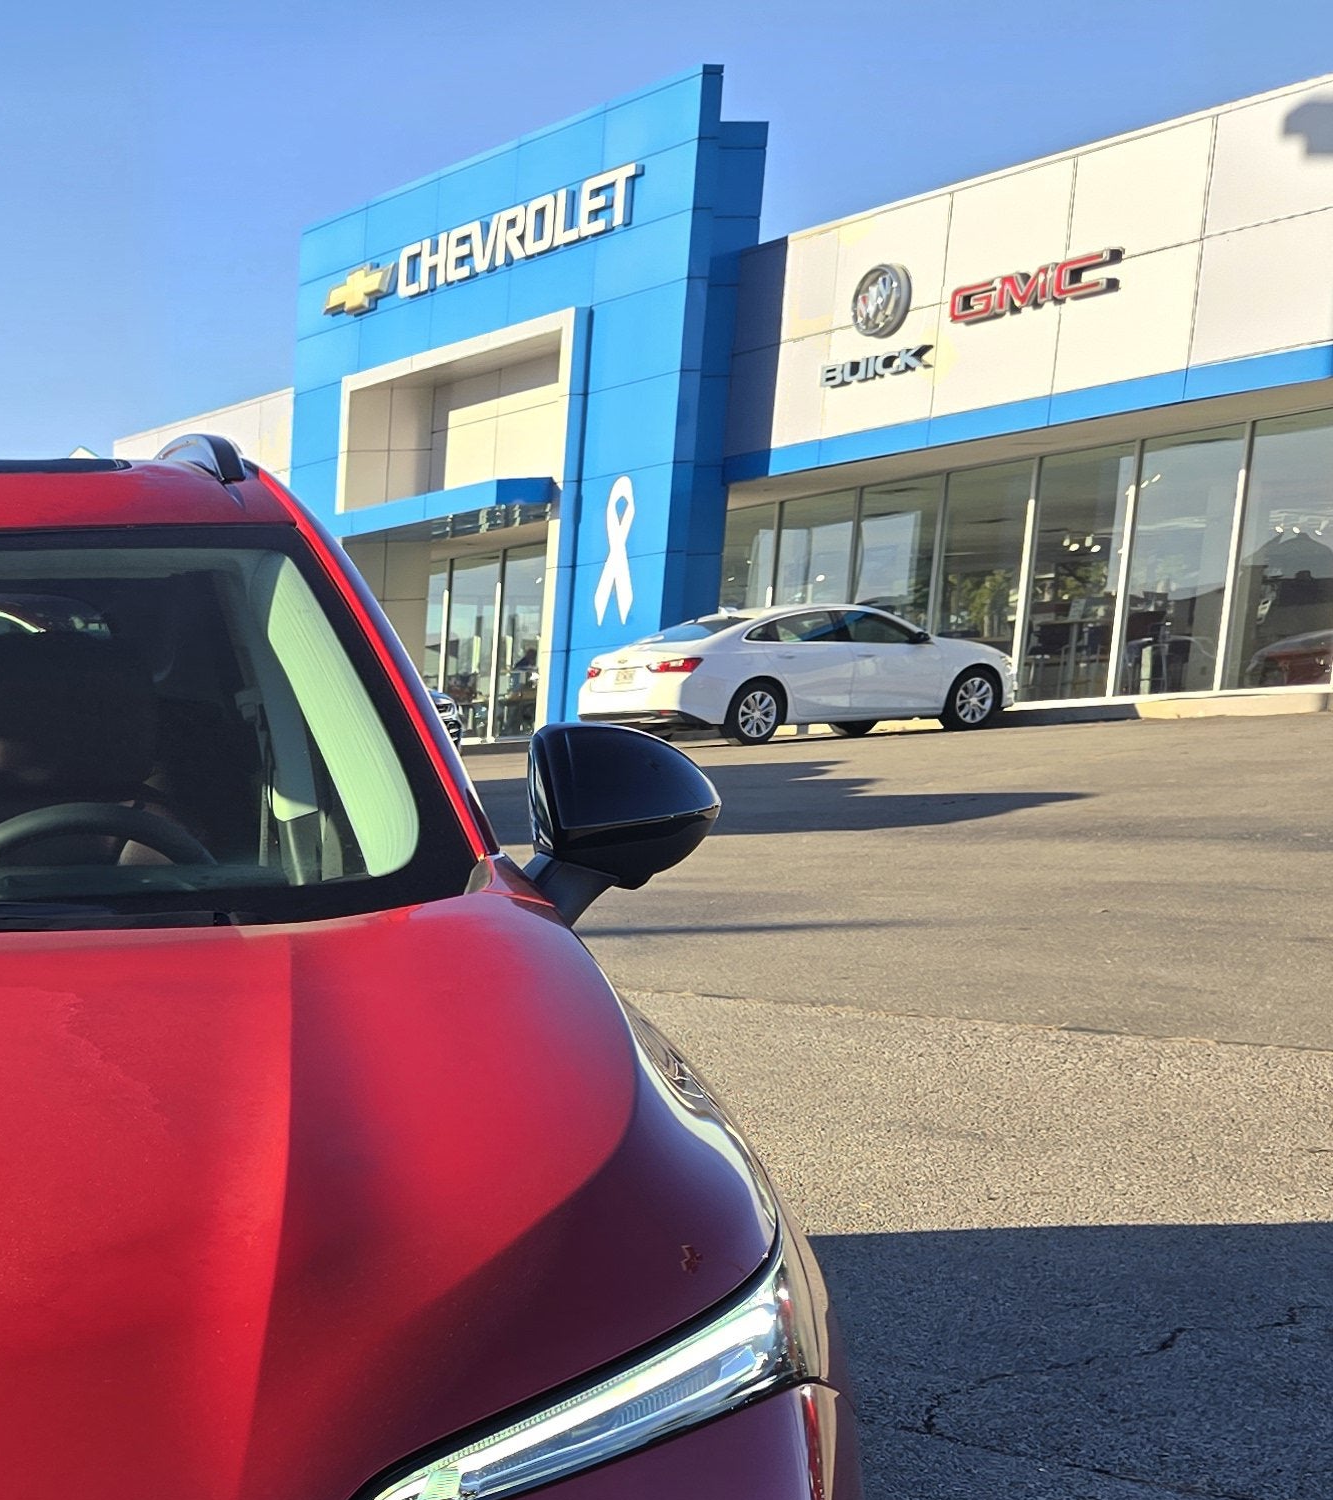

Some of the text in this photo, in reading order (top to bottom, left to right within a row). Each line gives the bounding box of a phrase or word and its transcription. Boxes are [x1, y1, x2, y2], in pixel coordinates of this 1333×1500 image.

[397, 162, 642, 299] CHEVROLET
[949, 247, 1125, 324] GMC
[819, 344, 935, 389] BUICK
